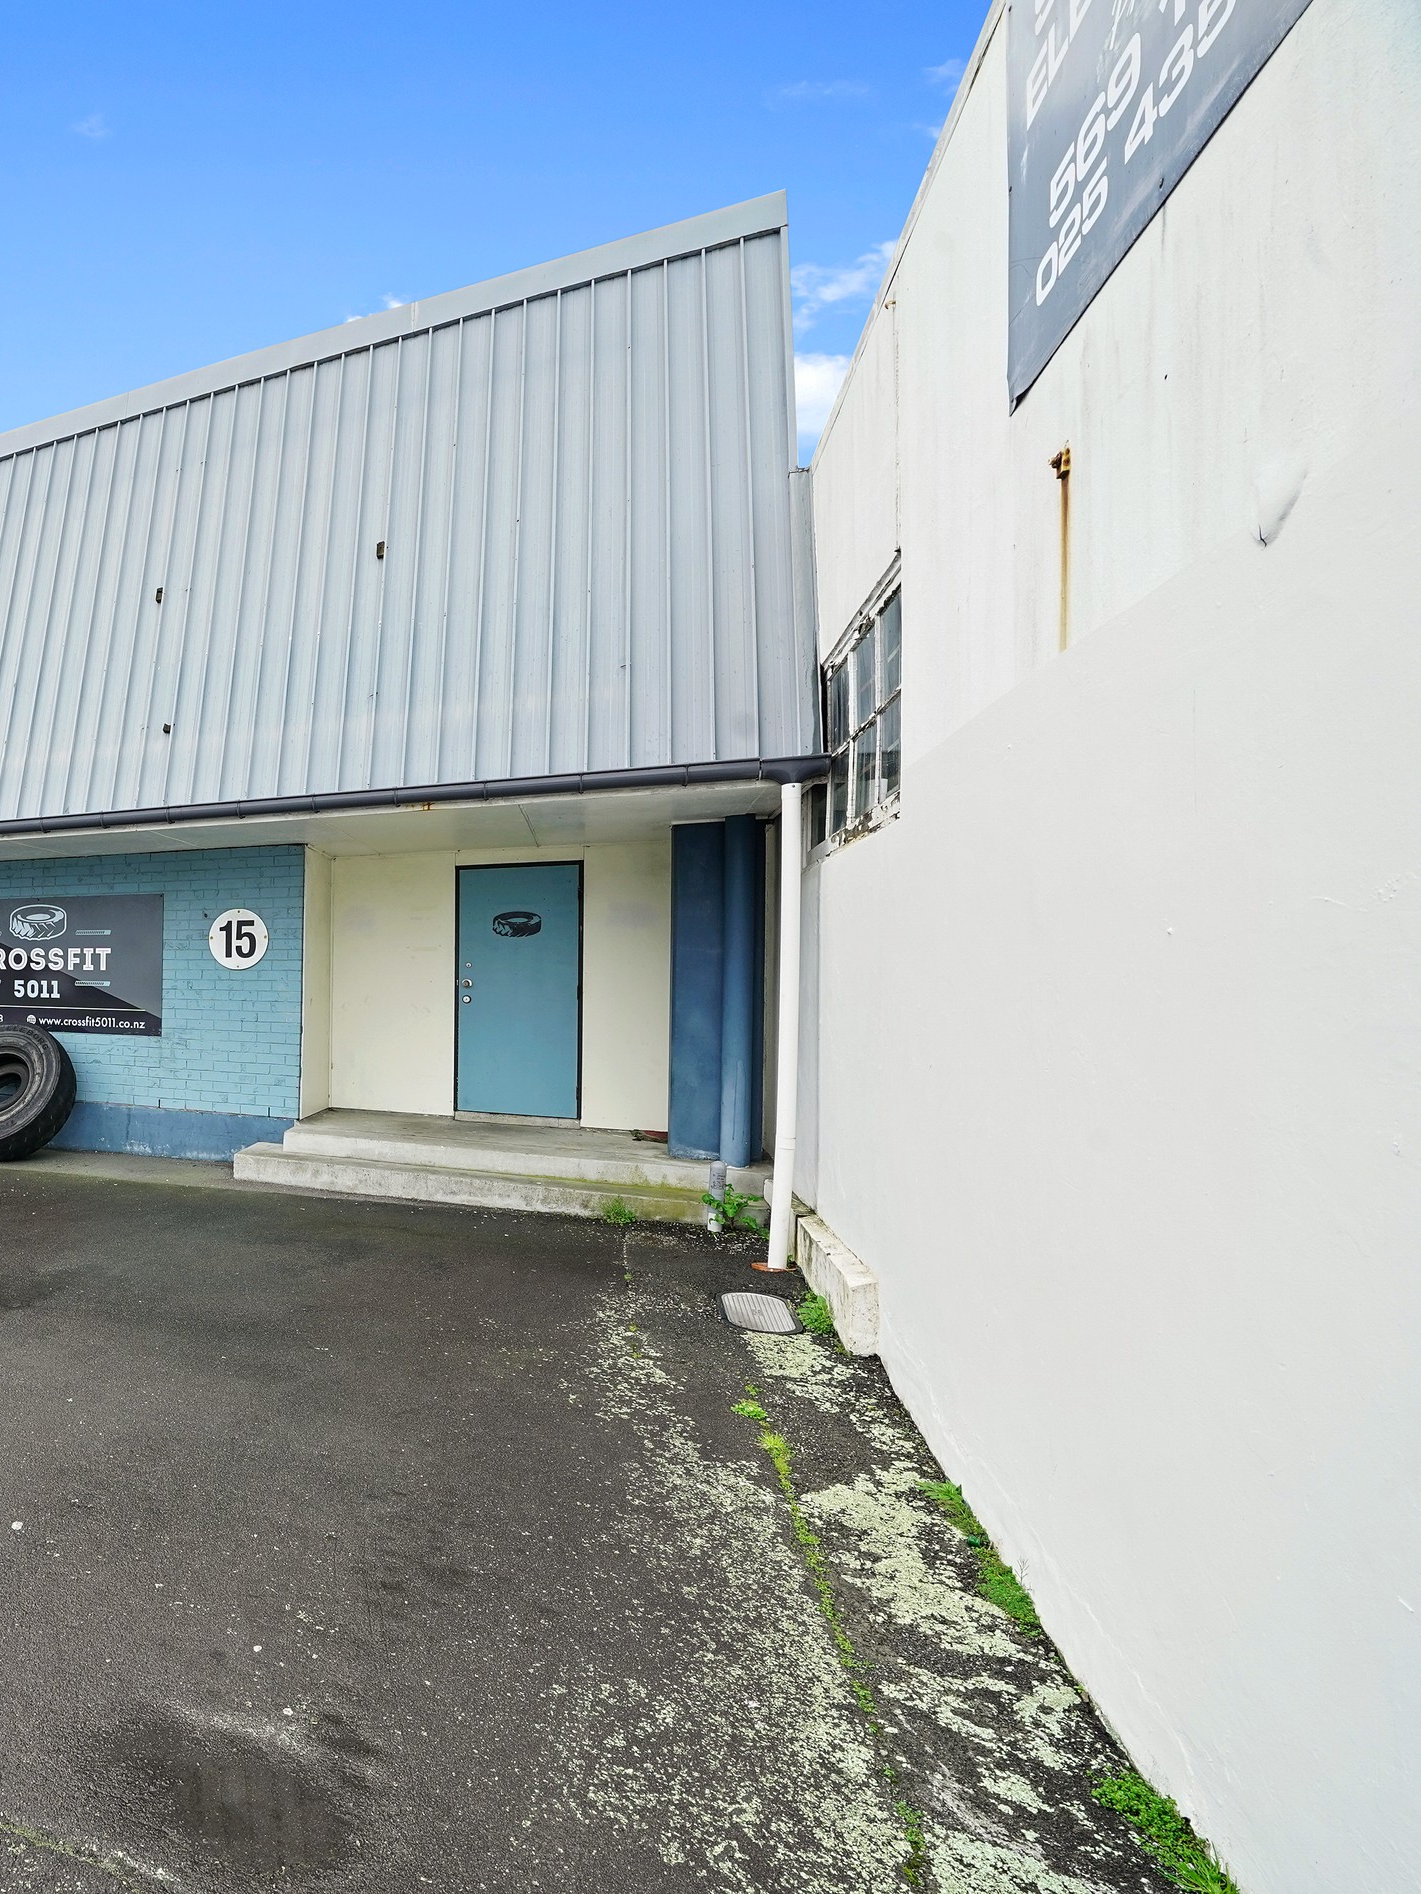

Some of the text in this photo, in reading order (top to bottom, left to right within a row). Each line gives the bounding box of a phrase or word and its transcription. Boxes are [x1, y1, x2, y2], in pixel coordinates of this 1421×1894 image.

[1049, 33, 1141, 229] 569
[1035, 0, 1237, 307] 025 435
[218, 919, 257, 958] 15
[13, 979, 61, 999] 5011
[38, 1015, 146, 1030] www.crossfit5011.co.nz
